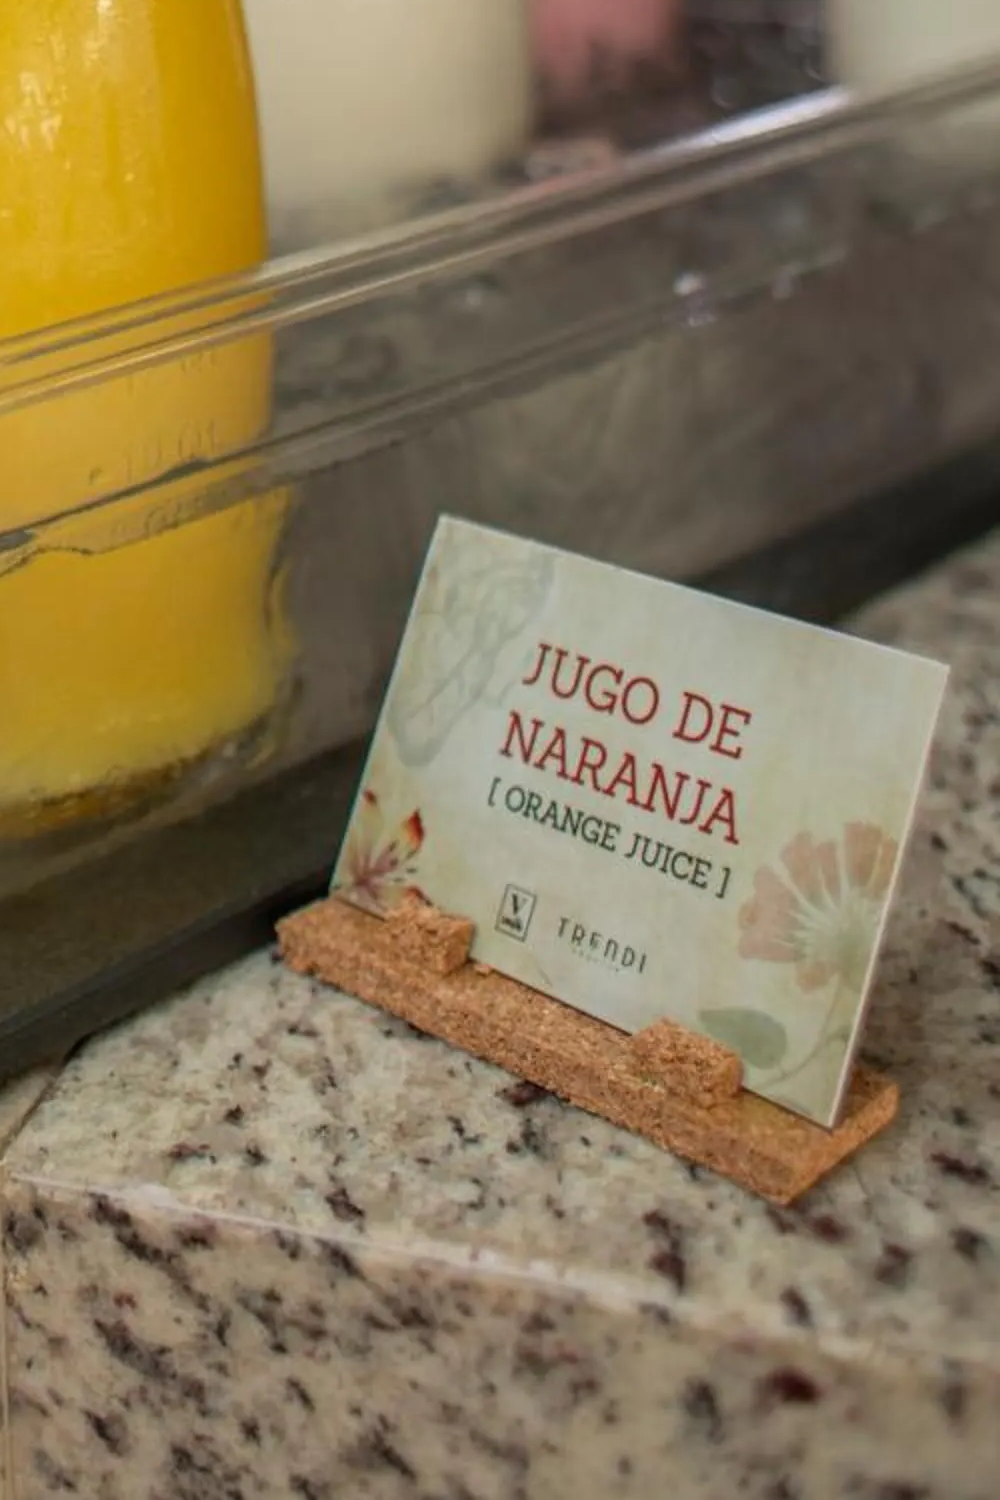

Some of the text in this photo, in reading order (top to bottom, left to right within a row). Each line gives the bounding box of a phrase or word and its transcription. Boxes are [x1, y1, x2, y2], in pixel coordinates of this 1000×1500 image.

[522, 642, 752, 760] JUGO DE
[500, 710, 739, 846] NARANJA
[557, 916, 648, 974] TRENDI
